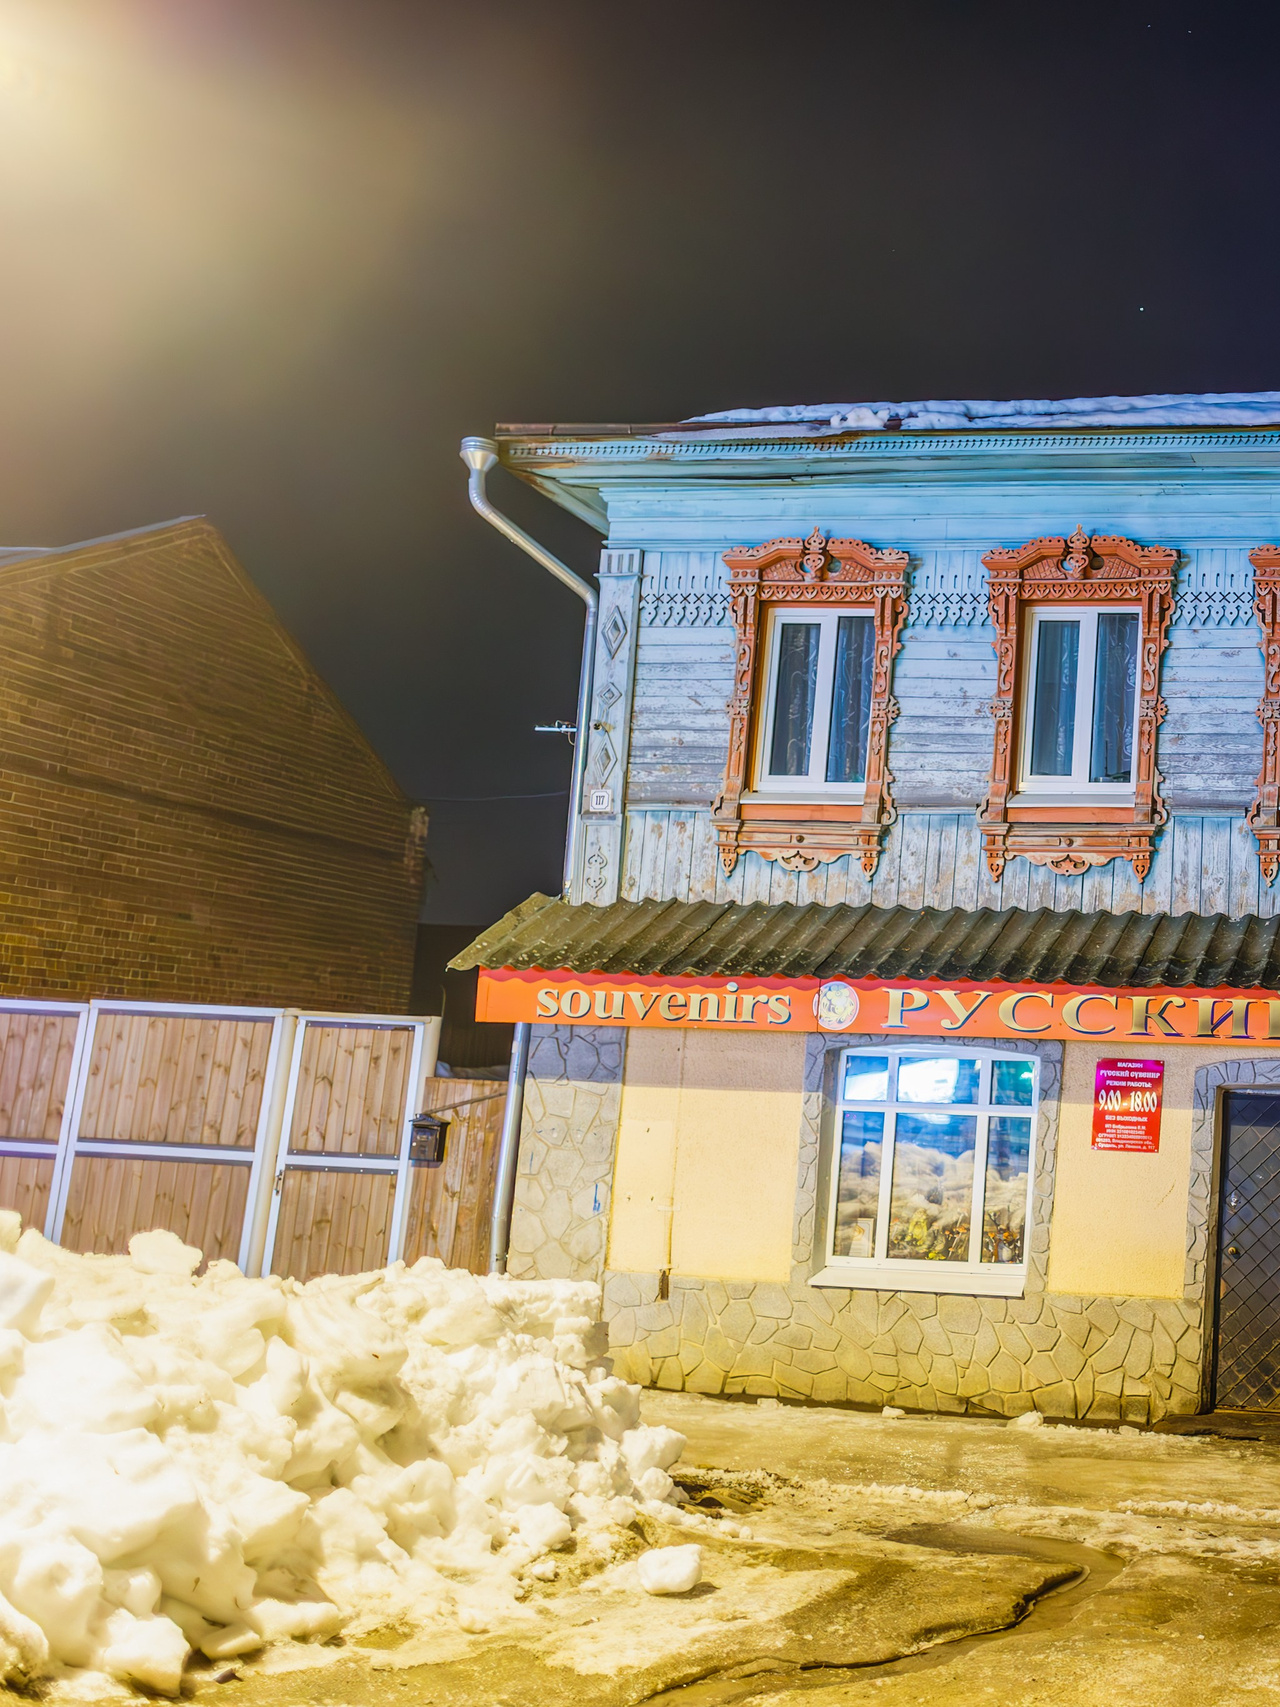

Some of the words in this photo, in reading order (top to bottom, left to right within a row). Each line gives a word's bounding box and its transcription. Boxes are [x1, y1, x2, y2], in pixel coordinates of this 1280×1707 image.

[595, 795, 605, 805] 117
[535, 981, 792, 1025] souvenirs
[1099, 1089, 1121, 1111] 9.00
[1130, 1091, 1157, 1112] 18.00
